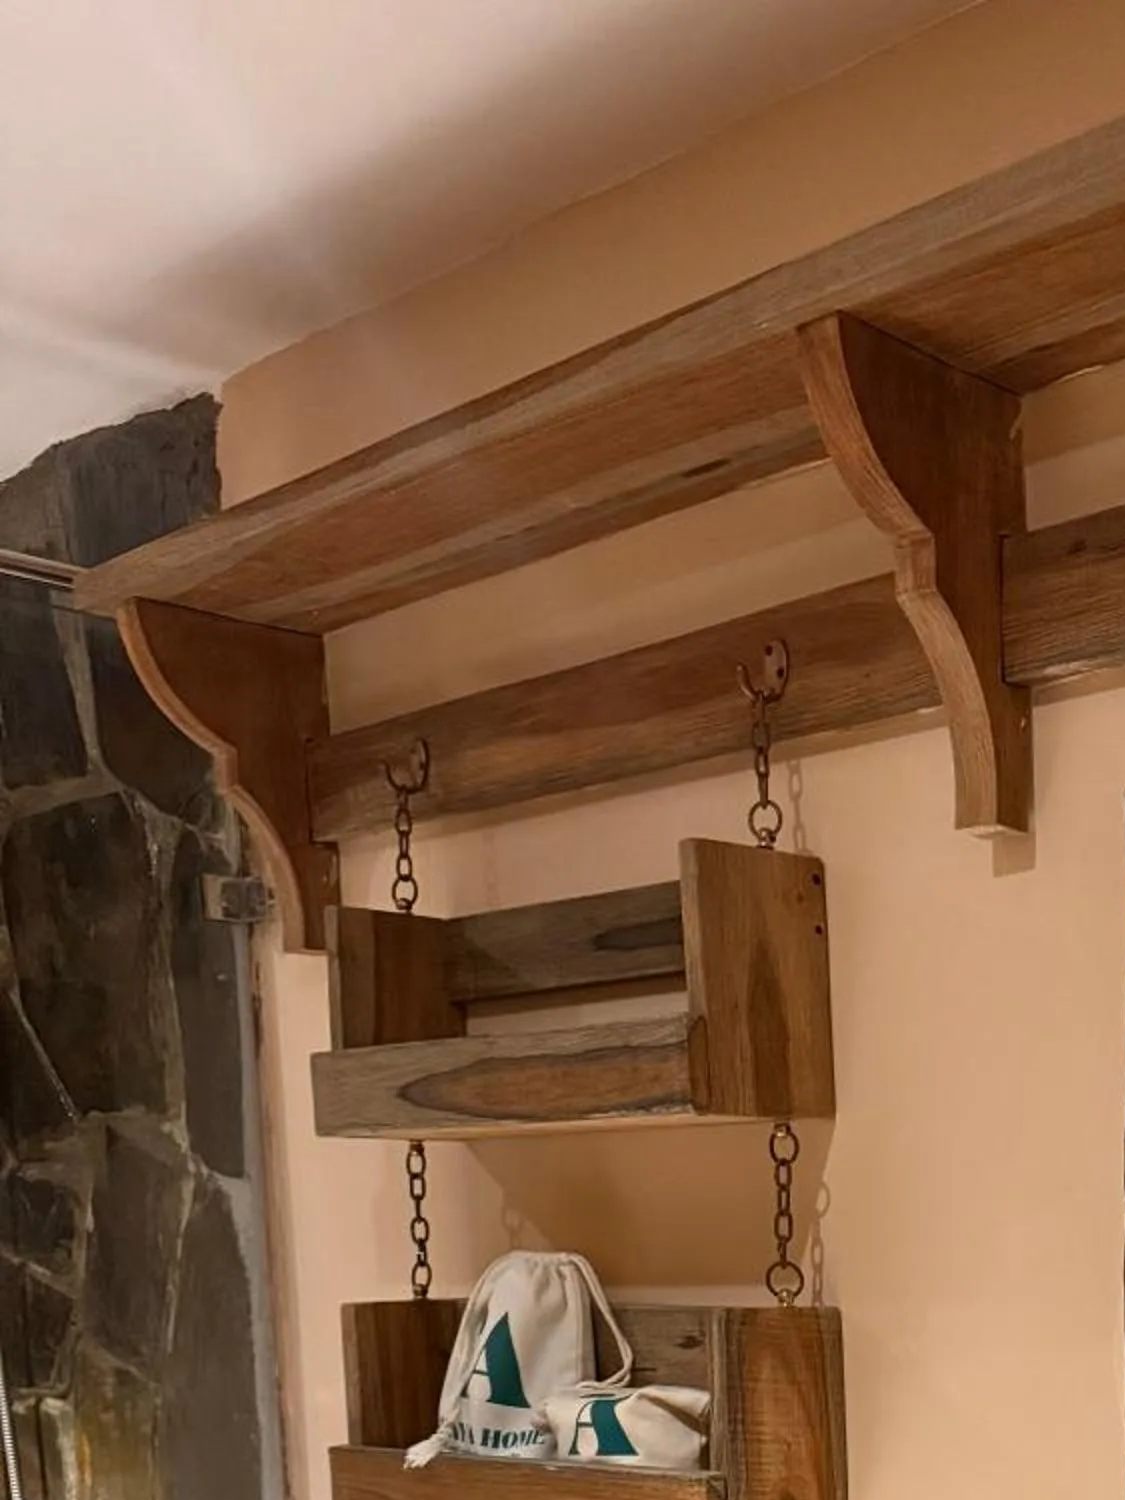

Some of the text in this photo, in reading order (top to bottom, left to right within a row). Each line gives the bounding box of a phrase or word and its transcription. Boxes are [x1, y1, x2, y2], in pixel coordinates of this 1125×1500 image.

[460, 1312, 531, 1408] A
[480, 1427, 545, 1448] HOME
[568, 1394, 639, 1456] A
